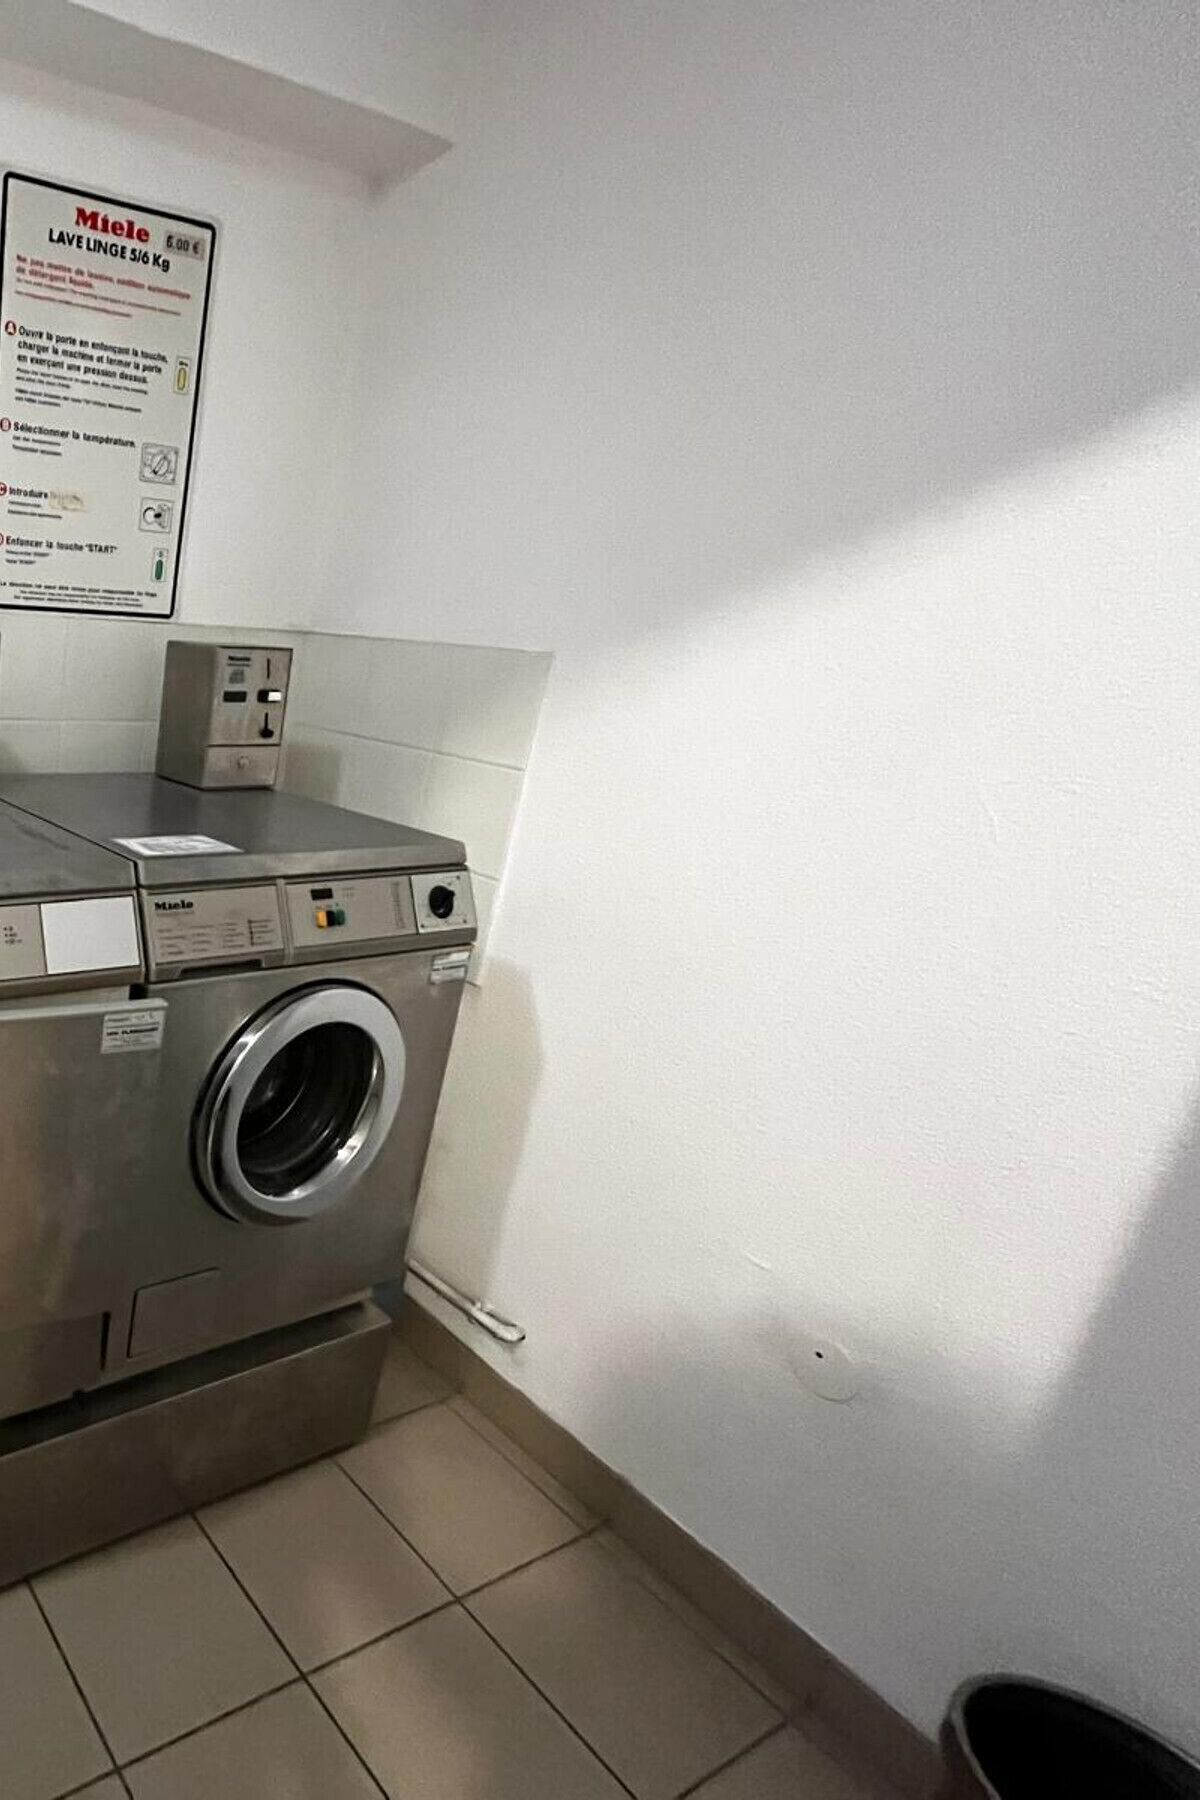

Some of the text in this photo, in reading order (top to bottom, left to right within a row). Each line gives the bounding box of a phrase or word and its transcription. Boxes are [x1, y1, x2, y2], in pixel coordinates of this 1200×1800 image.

[75, 206, 150, 243] Miele
[49, 228, 171, 274] LAVE LINGE 5/6 Kg
[166, 235, 200, 254] 6.00 €
[55, 334, 78, 348] porte
[79, 338, 90, 348] en
[17, 340, 50, 356] charger
[61, 347, 94, 362] machine
[96, 354, 105, 364] et
[106, 355, 133, 370] fermer
[142, 362, 163, 375] porte
[17, 354, 28, 364] en
[30, 355, 65, 371] exerçant
[66, 361, 81, 372] une
[83, 363, 117, 379] pression
[13, 421, 70, 440] Sélectionner
[9, 486, 49, 500] Introduire
[6, 536, 43, 549] Enfoncer
[56, 540, 84, 552] touche
[154, 899, 194, 912] Miele
